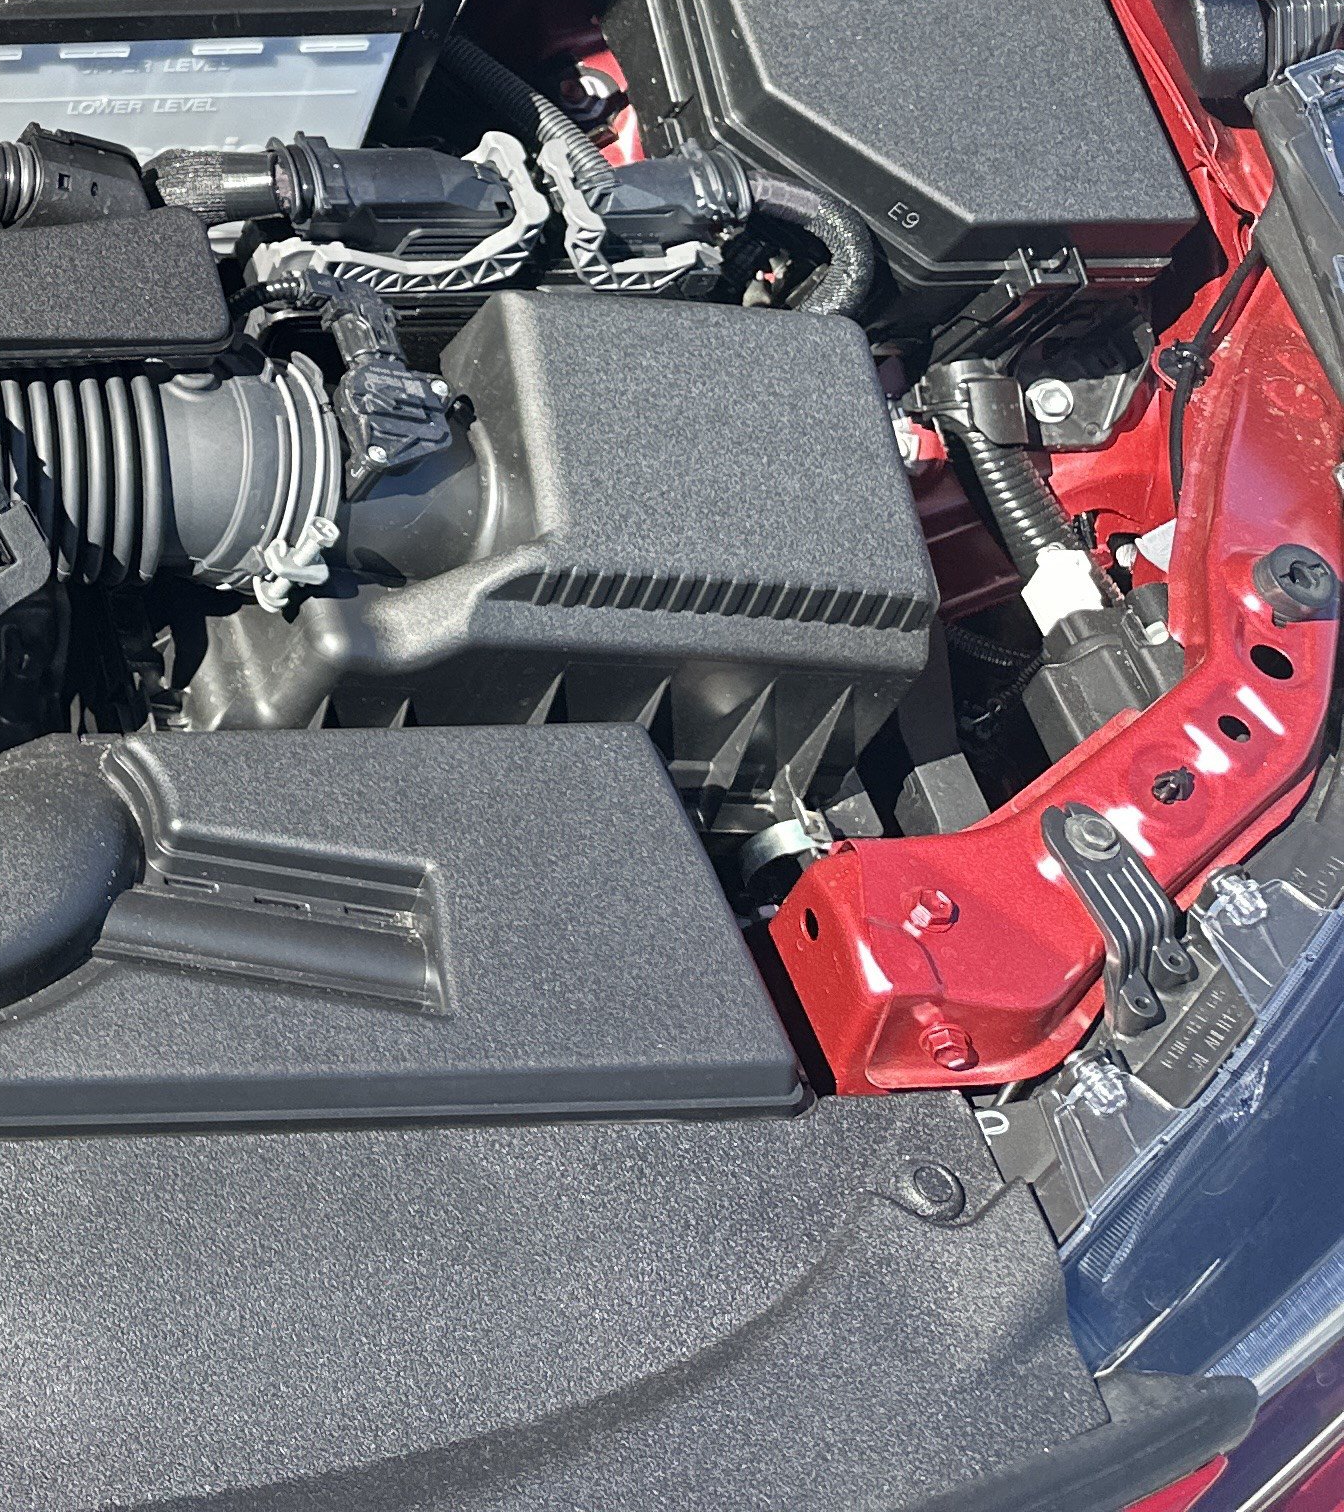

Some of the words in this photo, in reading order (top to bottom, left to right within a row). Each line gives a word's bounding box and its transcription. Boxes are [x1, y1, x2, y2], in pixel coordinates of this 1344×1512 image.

[66, 100, 144, 115] LOWER
[152, 98, 218, 114] LEVEL
[887, 201, 920, 228] E9
